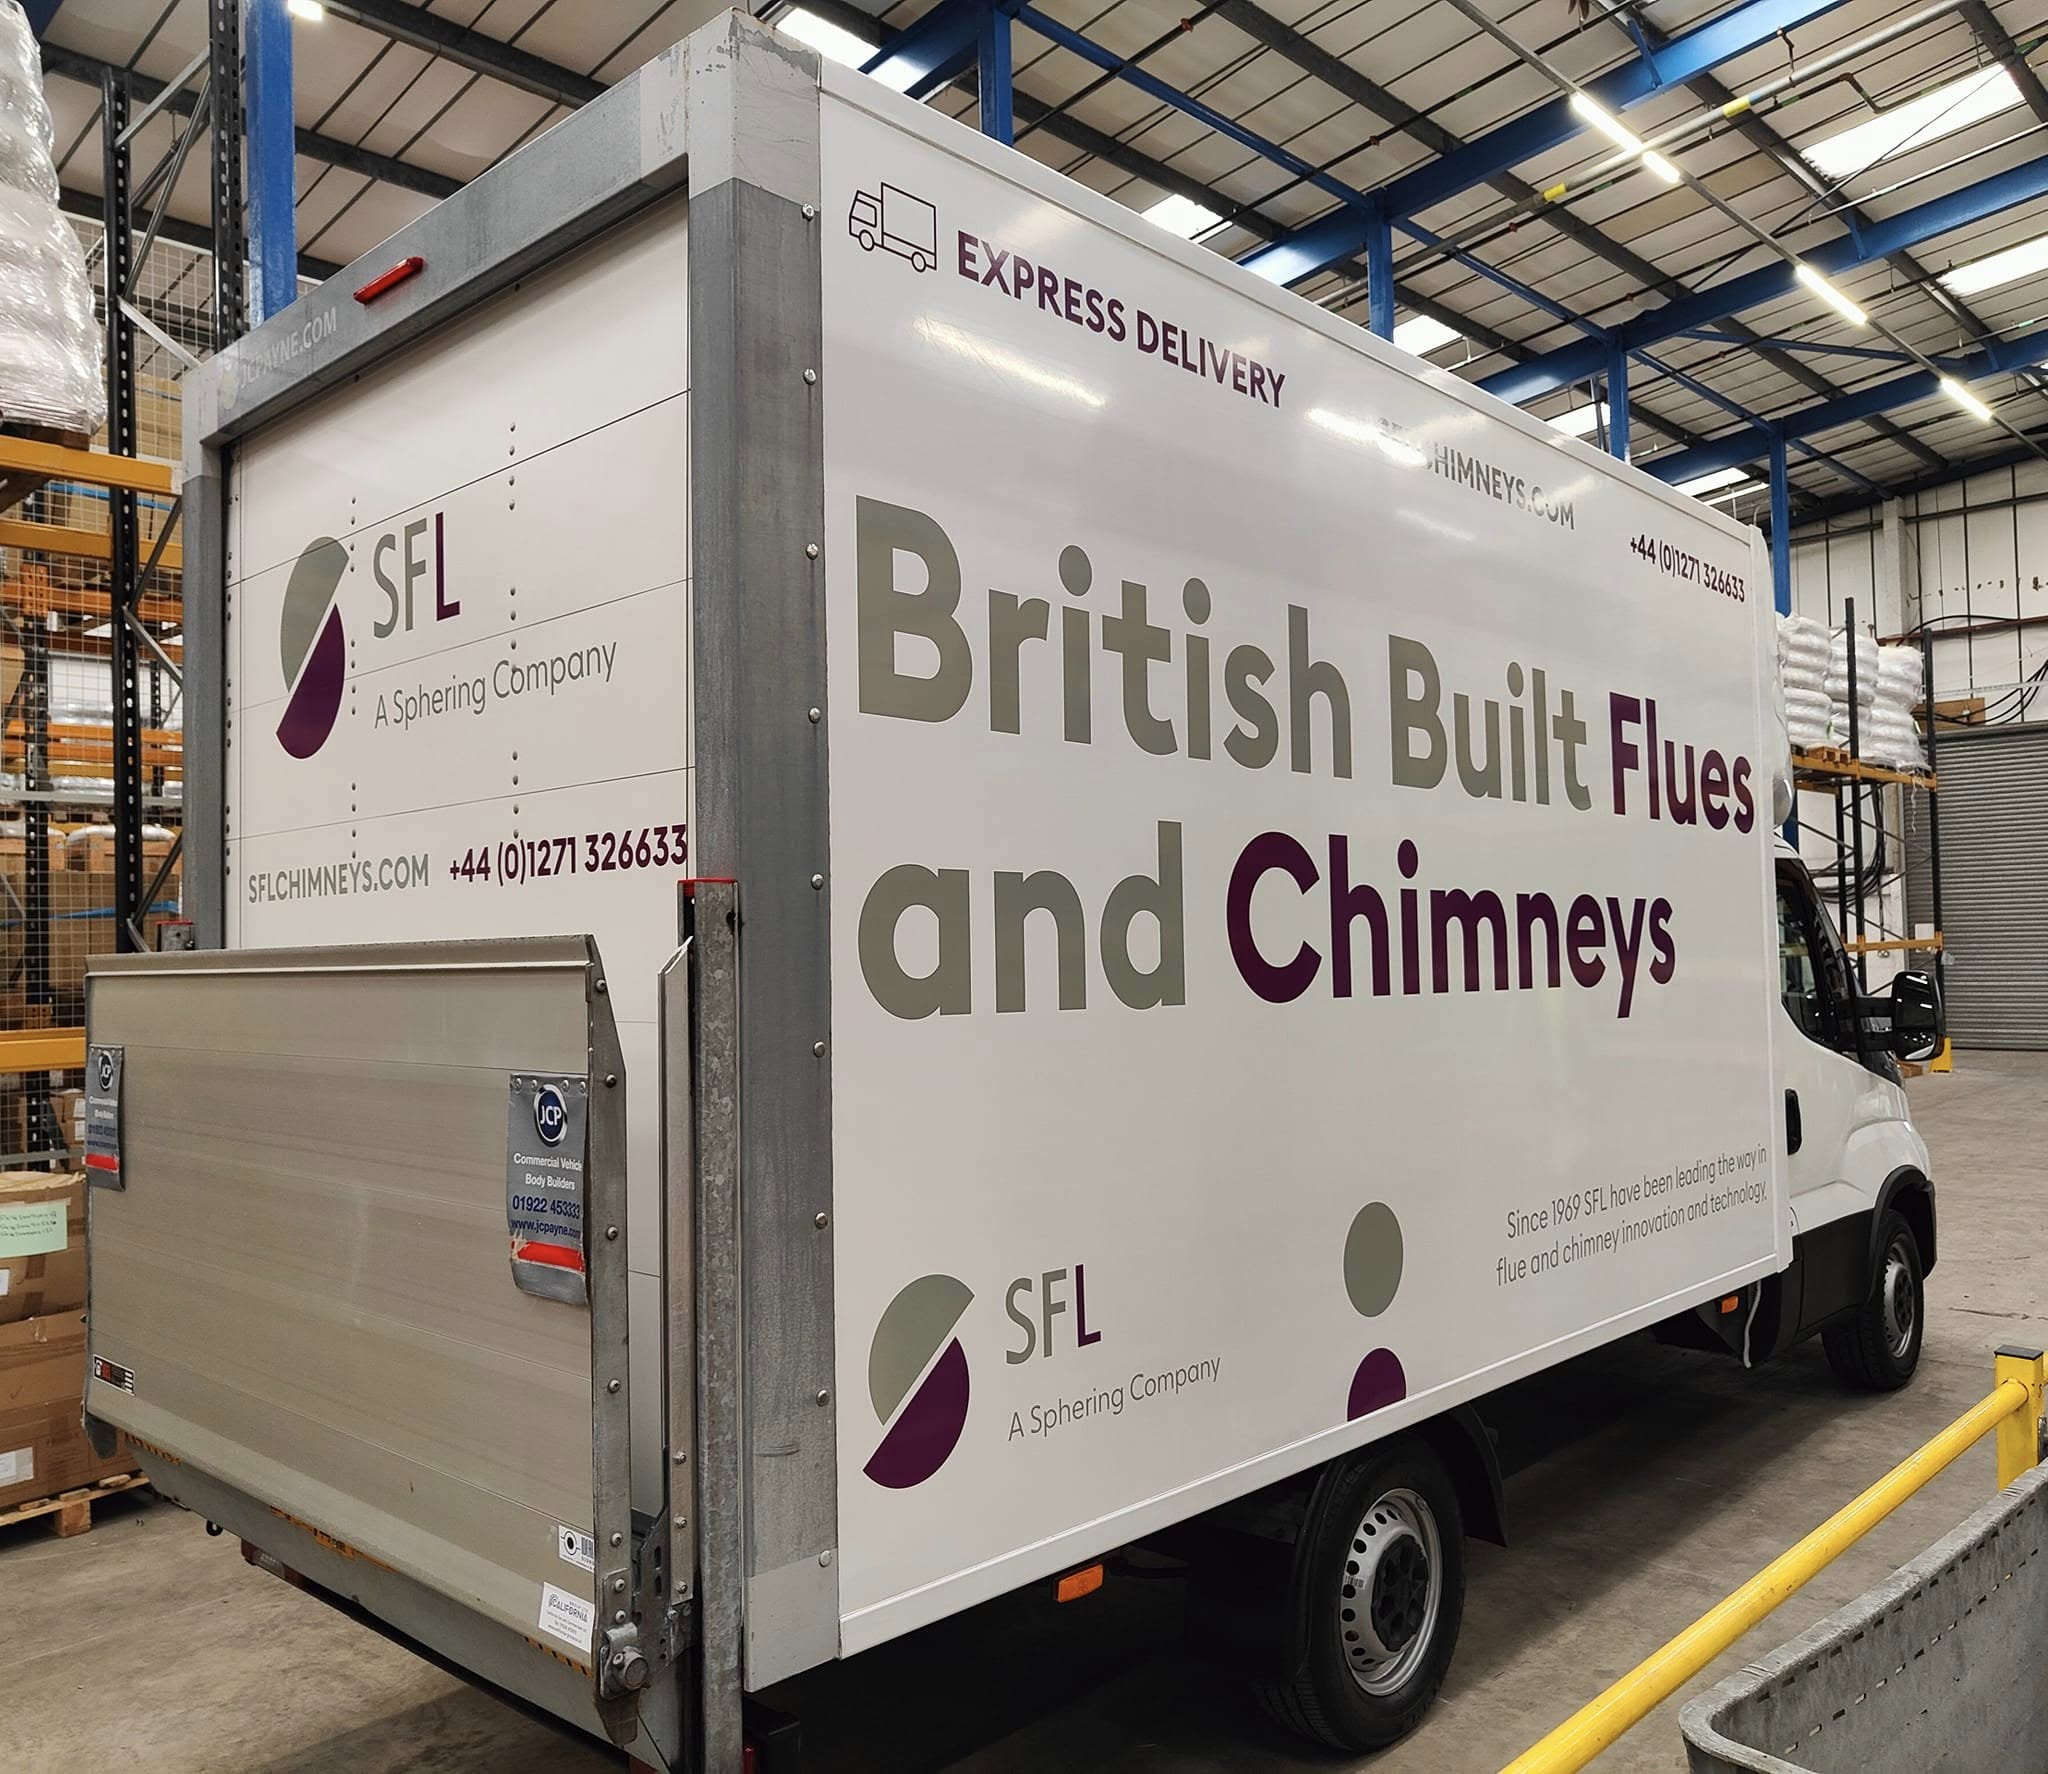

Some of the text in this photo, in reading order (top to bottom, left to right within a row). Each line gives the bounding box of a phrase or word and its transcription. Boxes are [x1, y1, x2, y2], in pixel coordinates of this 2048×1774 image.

[241, 306, 336, 389] JCPAYNE.COM
[957, 229, 1286, 409] EXPRESS DELIVERY
[1379, 416, 1574, 530] HIMNEYS.COM
[373, 511, 461, 639] SFL
[1630, 534, 1745, 603] +44 (0)1271 326633
[374, 641, 617, 731] A Sphering Company
[856, 495, 1755, 834] British Built Flues
[248, 824, 687, 904] SFLCHIMNEYS.COM +44 (0)1271 326633
[858, 820, 1676, 1020] and Chimneys
[539, 1105, 562, 1126] JCP
[513, 1152, 559, 1168] Commercial
[525, 1173, 576, 1190] Body Builders
[1507, 1143, 1767, 1239] Since 1969 SFL have been leading the way in
[512, 1195, 580, 1219] 01922 453333
[1495, 1179, 1767, 1286] flue and chimney innovation and technology.
[1005, 1263, 1102, 1365] SFL
[1008, 1356, 1221, 1442] A Sphering Company
[552, 1597, 588, 1623] CALIFORNIA
